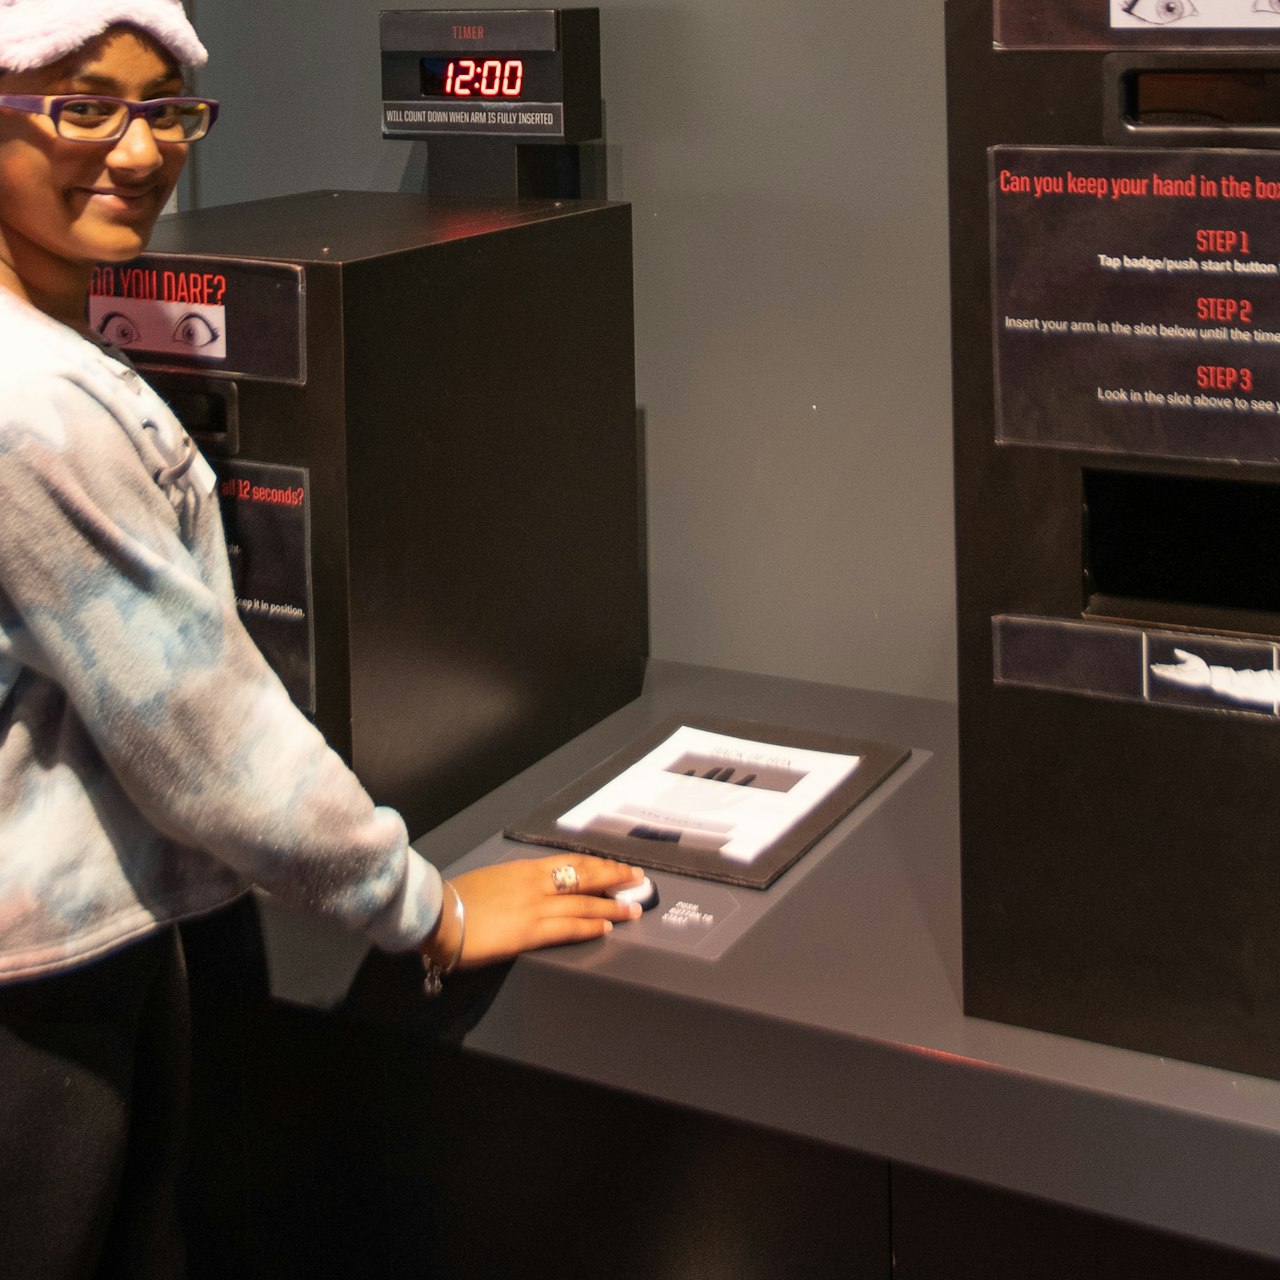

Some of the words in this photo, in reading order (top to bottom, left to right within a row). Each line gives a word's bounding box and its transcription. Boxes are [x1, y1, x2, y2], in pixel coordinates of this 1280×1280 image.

[452, 26, 484, 39] TIMER
[445, 60, 523, 96] 12:00
[386, 110, 403, 122] WILL
[404, 111, 426, 122] COUNT
[427, 111, 448, 123] DOWN
[449, 111, 469, 123] WHEN
[470, 112, 487, 123] ARM
[488, 112, 495, 124] IS
[497, 113, 517, 124] FULLY
[518, 113, 553, 125] INSERTED
[1000, 170, 1030, 193] Can
[1034, 177, 1063, 198] you
[1068, 172, 1108, 199] keep
[1112, 177, 1148, 200] your
[1154, 174, 1196, 198] hand
[1200, 175, 1217, 197] in
[1221, 176, 1251, 198] the
[1196, 229, 1237, 252] STEP
[1240, 231, 1250, 253] 1
[1098, 254, 1122, 268] Tap
[1123, 255, 1198, 272] badge/push
[1201, 259, 1232, 271] start
[1234, 259, 1276, 273] button
[90, 266, 114, 298] DO
[120, 268, 157, 301] YOU
[163, 271, 226, 307] DARE?
[1197, 297, 1237, 320] STEP
[1240, 300, 1251, 322] 2
[1005, 316, 1039, 329] Insert
[1042, 319, 1068, 333] your
[1070, 322, 1094, 332] arm
[1098, 320, 1109, 332] in
[1112, 321, 1130, 334] the
[1134, 322, 1158, 336] slot
[1160, 324, 1197, 338] below
[1200, 326, 1228, 339] until
[1230, 328, 1250, 341] the
[1197, 366, 1237, 389] STEP
[1240, 368, 1253, 391] 3
[1098, 387, 1127, 402] Look
[1130, 389, 1142, 402] in
[1144, 390, 1164, 404] the
[1167, 392, 1191, 406] slot
[1194, 394, 1233, 408] above
[1234, 397, 1248, 409] to
[1250, 399, 1275, 411] see
[223, 479, 235, 496] all
[237, 479, 250, 498] 12
[252, 486, 304, 506] seconds?
[254, 598, 260, 609] it
[261, 600, 269, 611] in
[270, 603, 305, 617] position.
